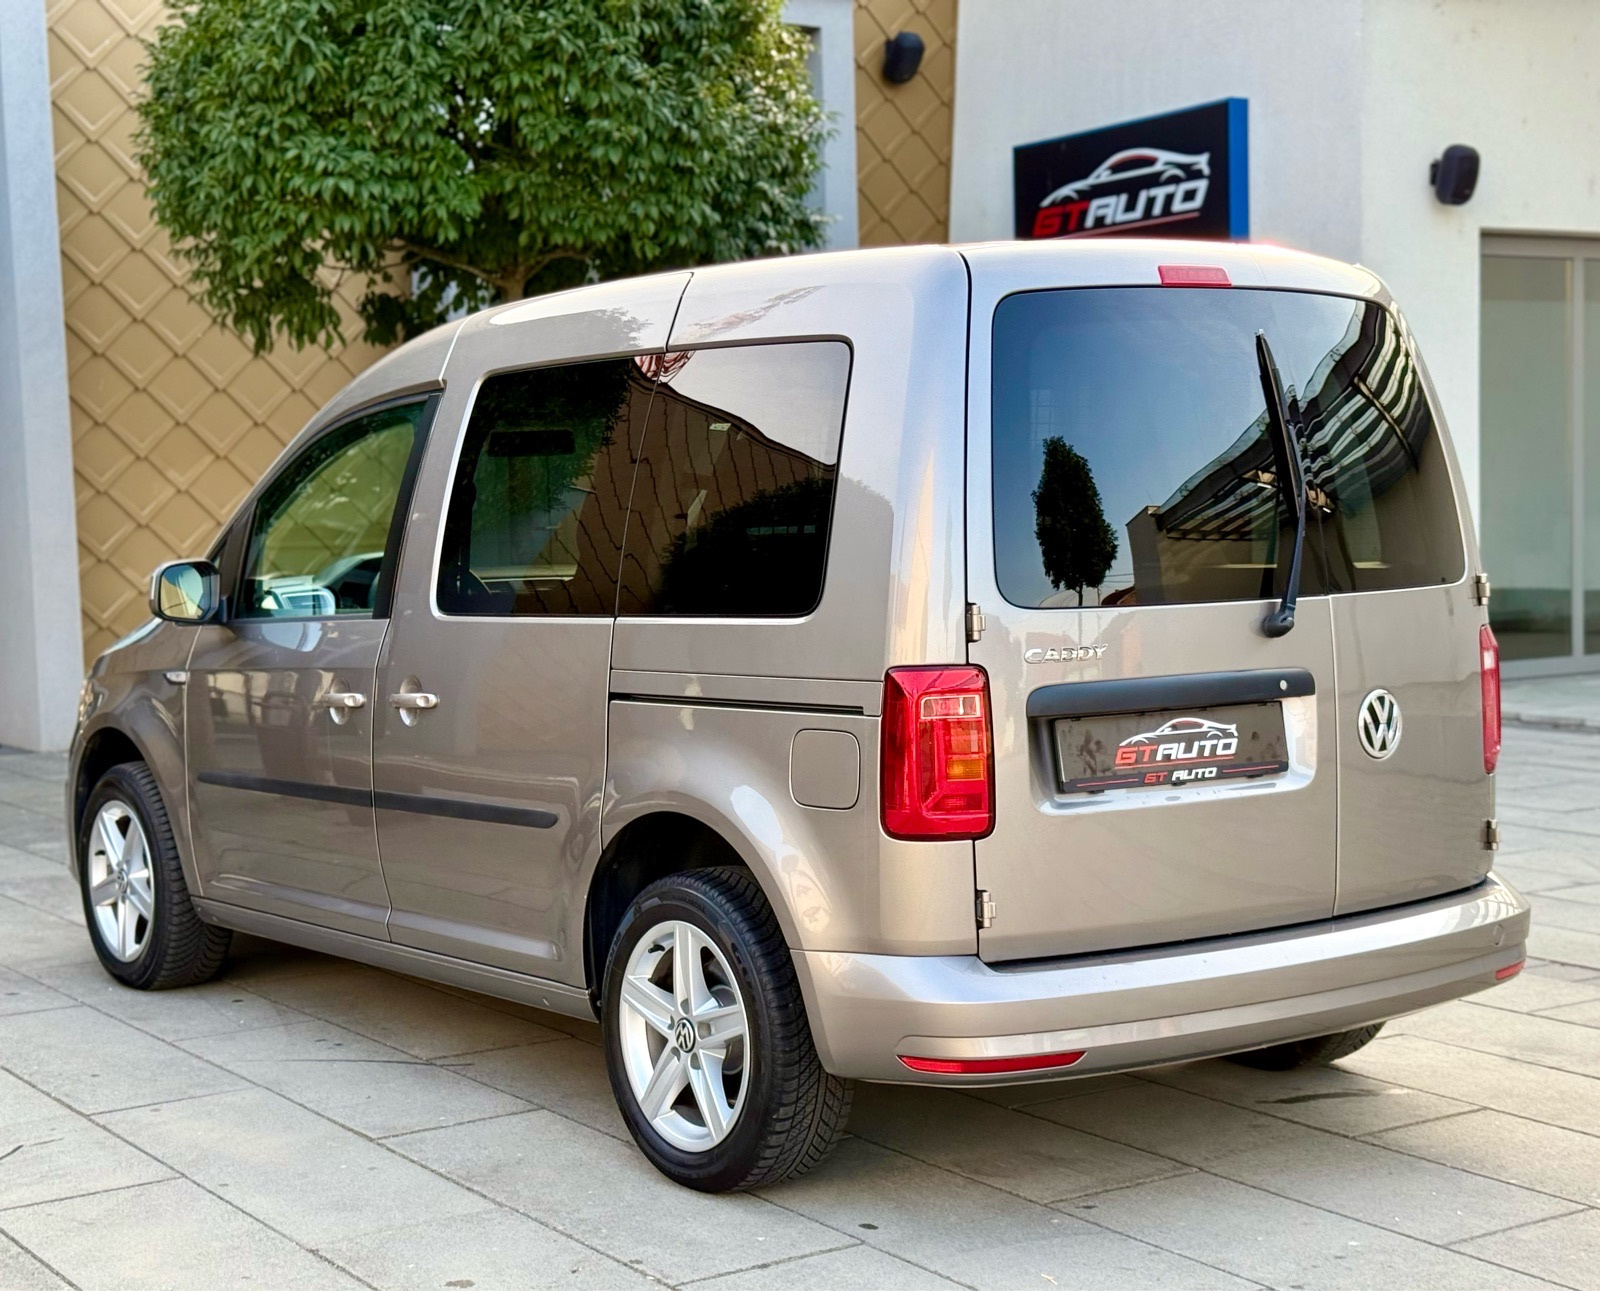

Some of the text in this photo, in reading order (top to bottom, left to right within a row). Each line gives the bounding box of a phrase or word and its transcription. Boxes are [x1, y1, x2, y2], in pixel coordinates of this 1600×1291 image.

[1023, 643, 1109, 665] CADDY
[1144, 766, 1218, 784] GT AUTO
